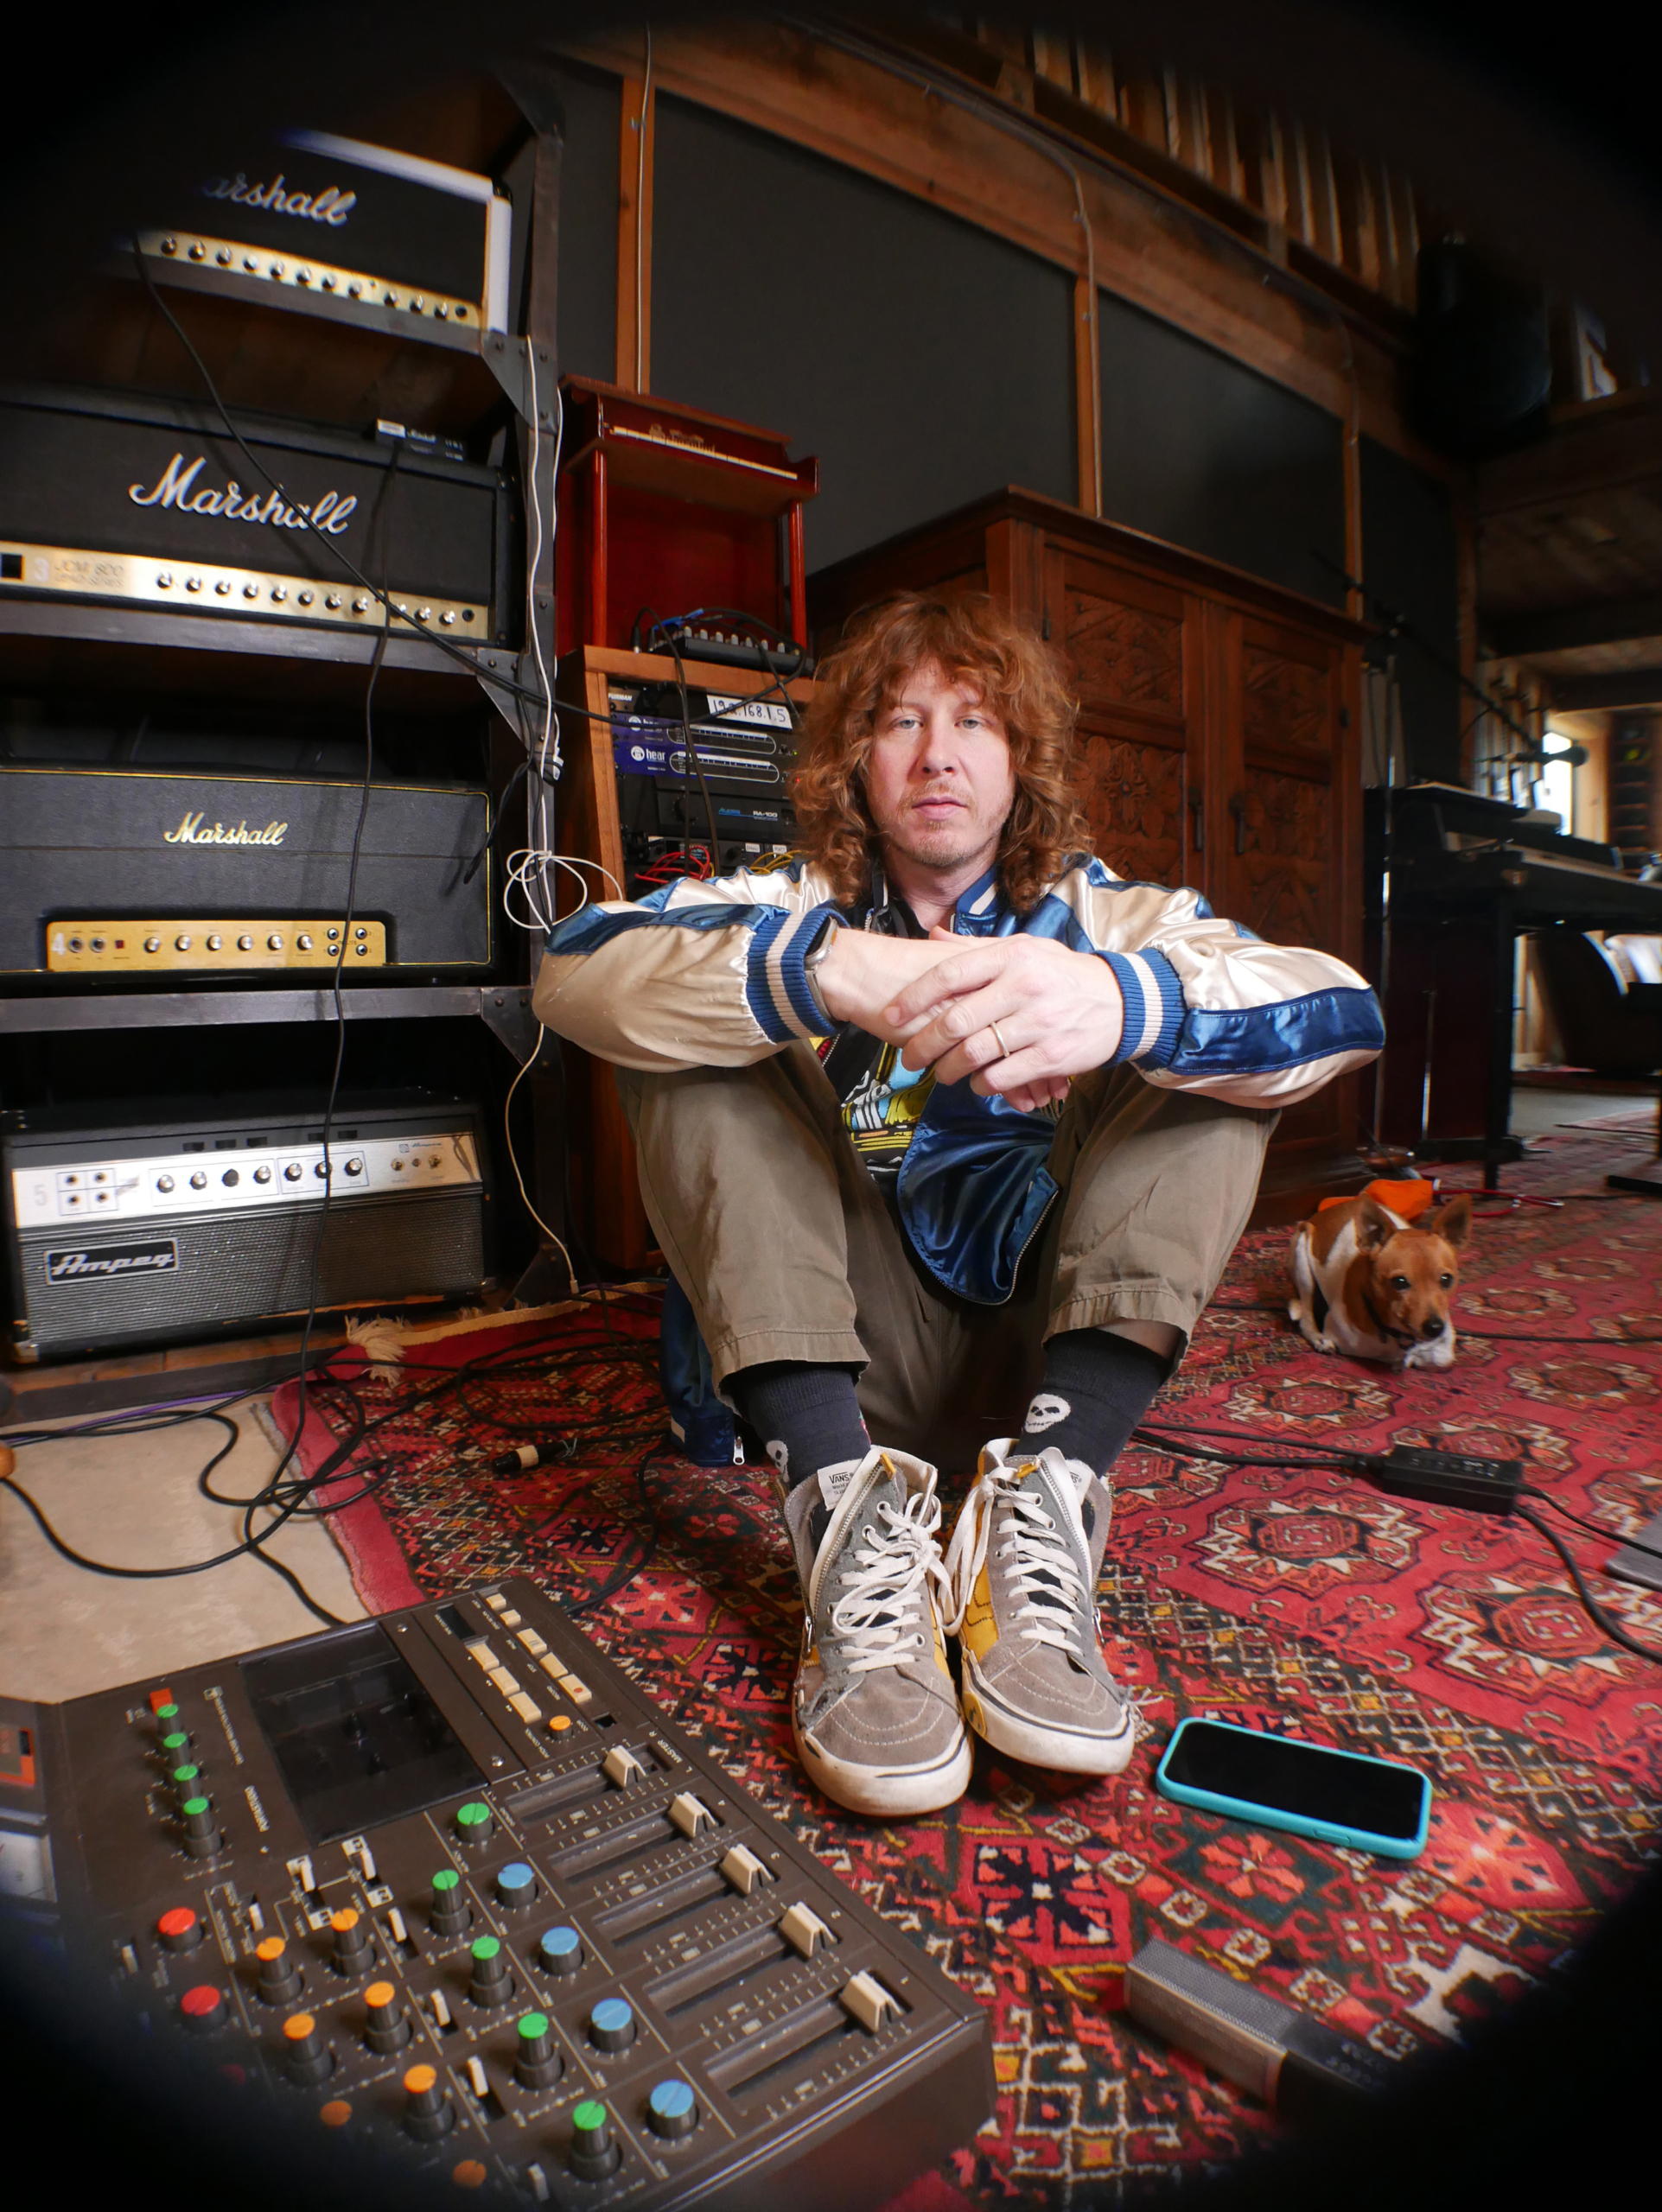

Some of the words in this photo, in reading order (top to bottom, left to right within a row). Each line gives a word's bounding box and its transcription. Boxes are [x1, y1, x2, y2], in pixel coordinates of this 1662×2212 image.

[202, 172, 357, 228] arshall
[128, 453, 358, 535] Marshall
[35, 557, 50, 583] 3
[646, 748, 665, 760] hear
[162, 811, 289, 846] Marshall
[52, 932, 66, 956] 4
[35, 1185, 46, 1206] 5
[51, 1253, 175, 1276] Ampeg
[658, 1739, 683, 1764] MASTER
